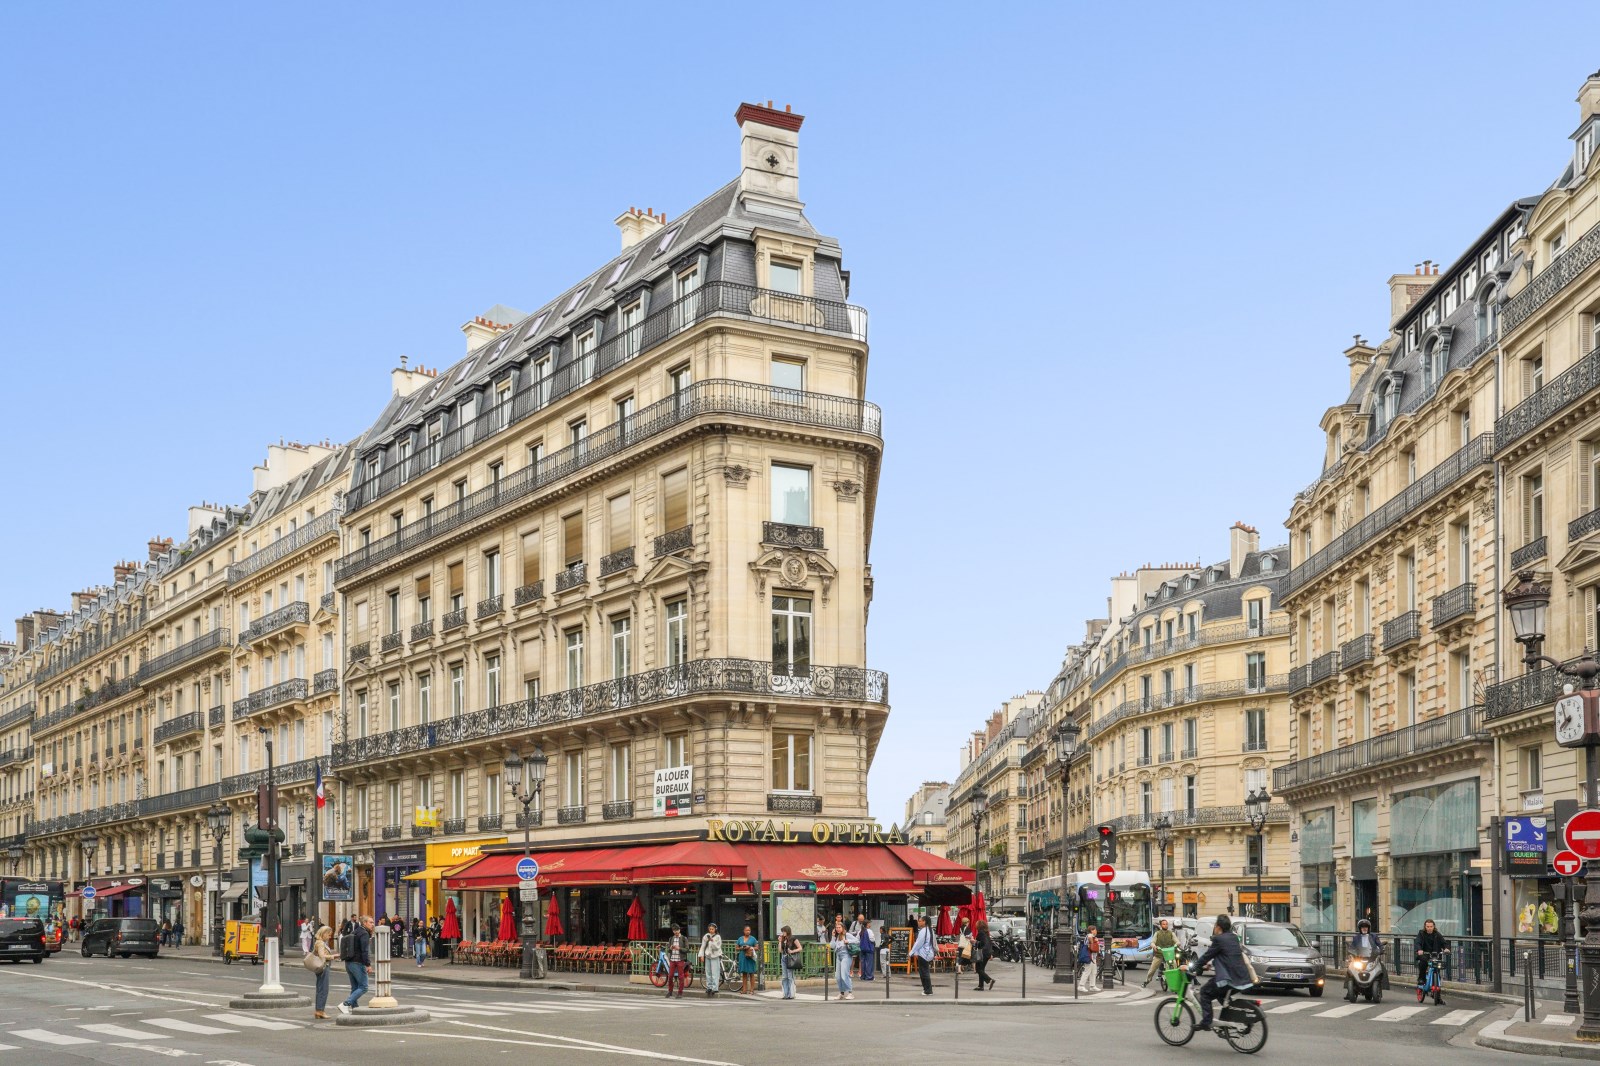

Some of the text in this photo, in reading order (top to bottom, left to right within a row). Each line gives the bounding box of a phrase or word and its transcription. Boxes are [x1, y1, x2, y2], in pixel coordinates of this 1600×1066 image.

[657, 770, 689, 782] A LOUER
[656, 782, 689, 794] BUREAUX
[706, 819, 905, 844] ROYAL OPERA
[1507, 821, 1522, 840] P
[452, 846, 479, 856] POP MART
